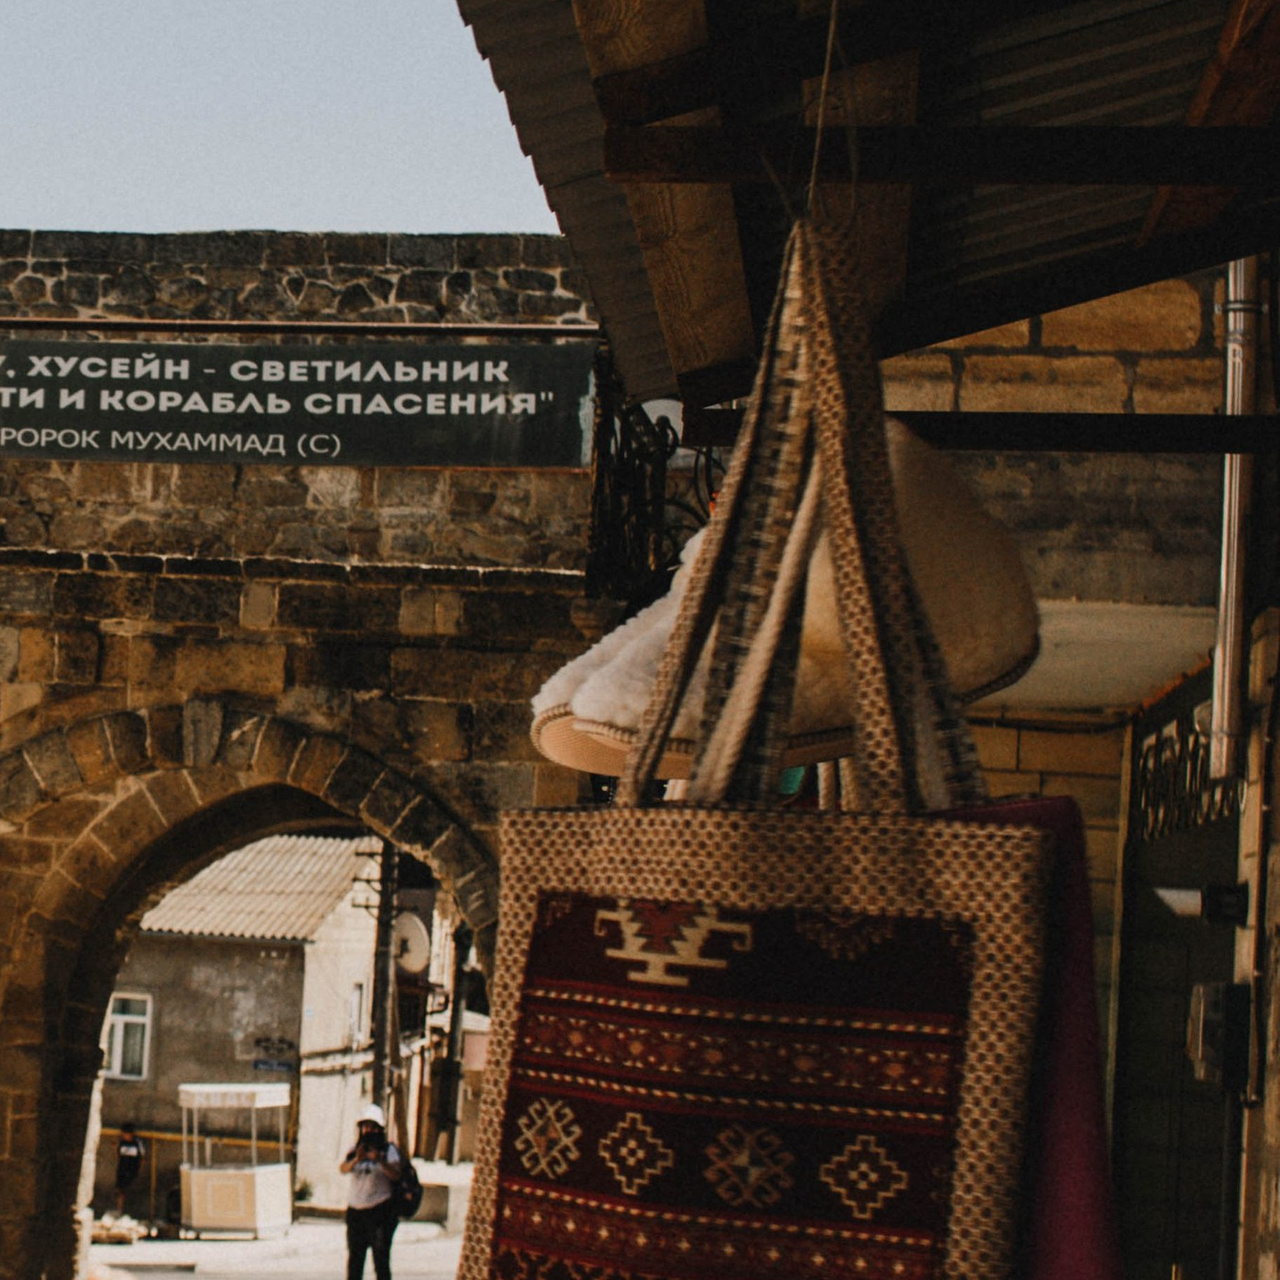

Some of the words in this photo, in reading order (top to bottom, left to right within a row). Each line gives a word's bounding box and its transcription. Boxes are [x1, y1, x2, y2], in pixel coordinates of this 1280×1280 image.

[26, 352, 191, 381] ХУСЕЙН
[228, 359, 510, 383] СВЕТИЛЬНИК
[58, 388, 86, 411] И
[98, 389, 293, 416] КОРАБЛЬ
[303, 391, 555, 416] СПАСЕНИЯ"
[110, 430, 287, 457] МУХАММАД
[296, 434, 342, 458] (С)
